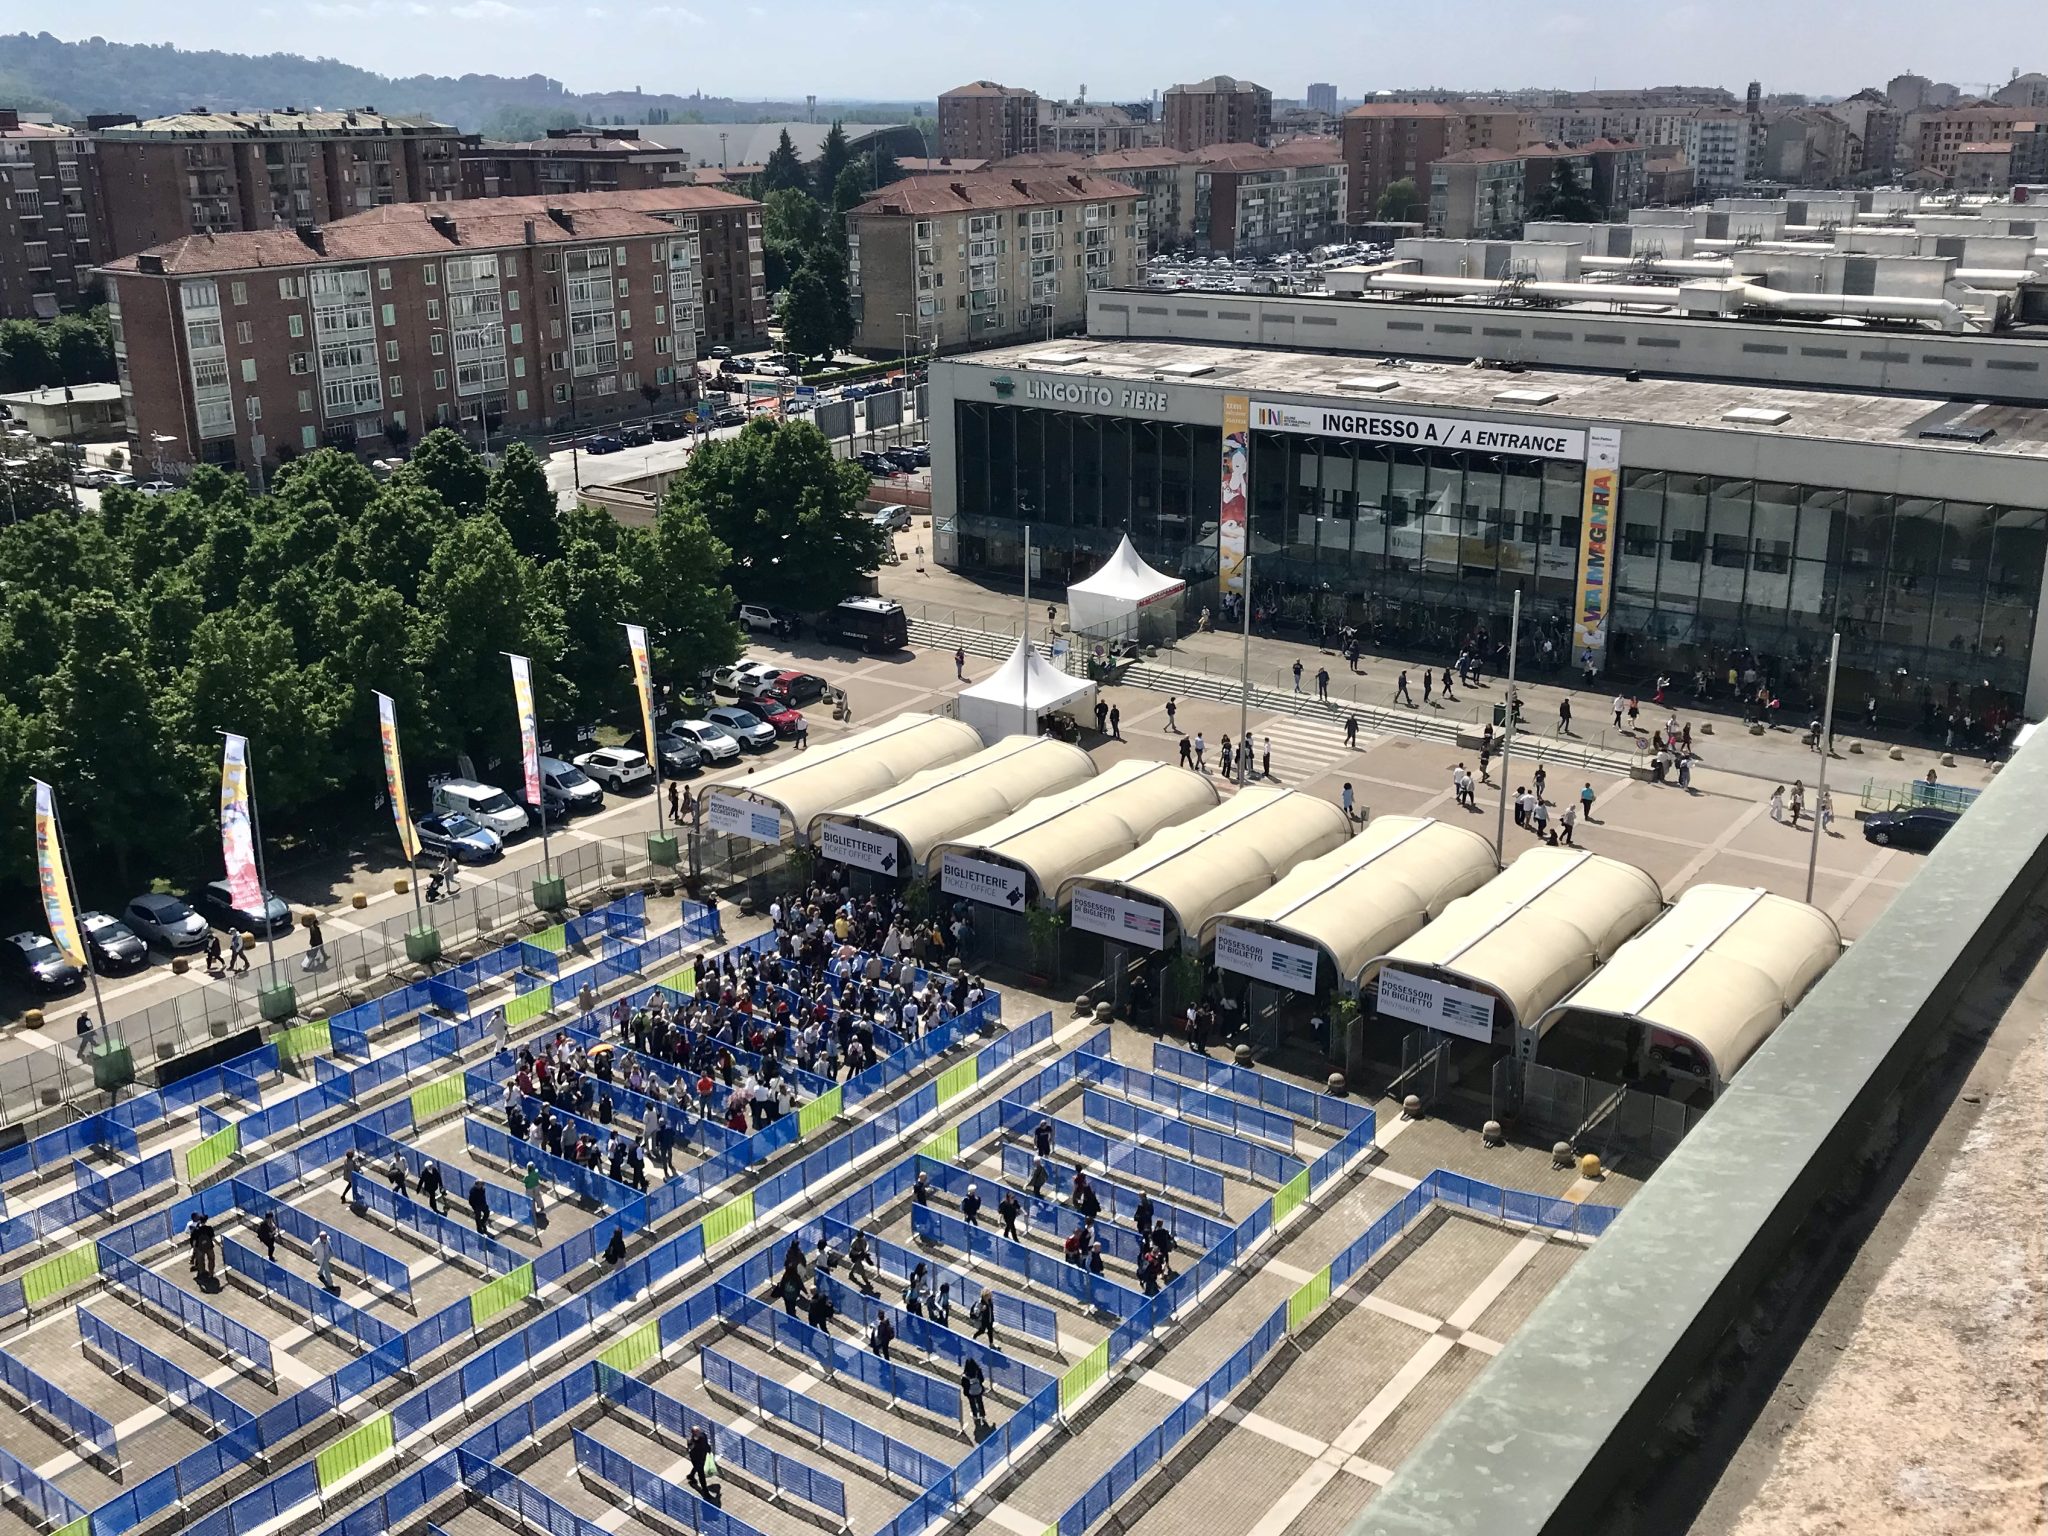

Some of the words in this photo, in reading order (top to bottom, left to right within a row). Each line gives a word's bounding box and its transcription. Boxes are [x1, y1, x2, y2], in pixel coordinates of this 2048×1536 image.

[1026, 380, 1113, 407] LINGOTTO
[1121, 390, 1168, 412] FIERE
[1322, 413, 1419, 439] INGRESSO
[1424, 423, 1438, 441] A
[1460, 430, 1472, 443] A
[1476, 431, 1567, 453] ENTRANCE
[823, 832, 882, 856] BIGLIETTERIE
[824, 842, 847, 856] TICKET
[848, 849, 873, 863] OFFICE
[944, 864, 1008, 890] BIGLIETTERIE
[944, 876, 969, 889] TICKET
[970, 883, 996, 897] OFFICE
[1074, 898, 1115, 915] POSSESSORI
[1074, 904, 1081, 912] DI
[1082, 907, 1116, 922] BIGLIETTO
[1218, 936, 1263, 955] POSSESSORI
[1218, 943, 1226, 951] DI
[1227, 946, 1263, 963] BIGLIETTO
[1381, 988, 1390, 996] DI
[1391, 991, 1433, 1009] BIGLIETTO
[1382, 980, 1433, 1001] POSSESSORI
